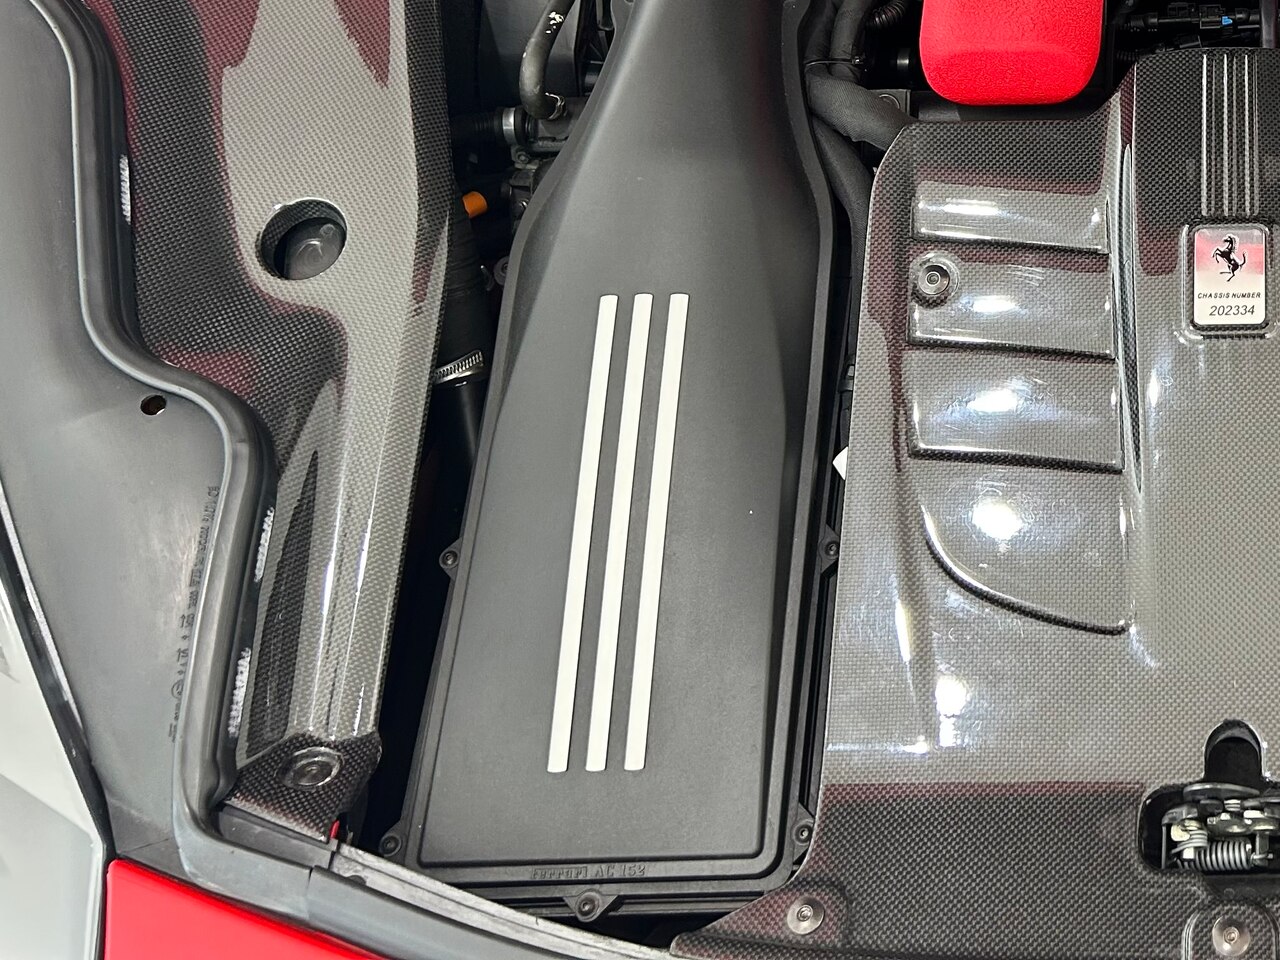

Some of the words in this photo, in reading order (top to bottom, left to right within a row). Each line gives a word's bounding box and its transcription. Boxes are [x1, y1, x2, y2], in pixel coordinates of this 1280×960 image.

[1209, 304, 1256, 317] 202334
[531, 865, 588, 880] Ferrari
[594, 863, 615, 879] AC
[622, 862, 646, 878] 152
